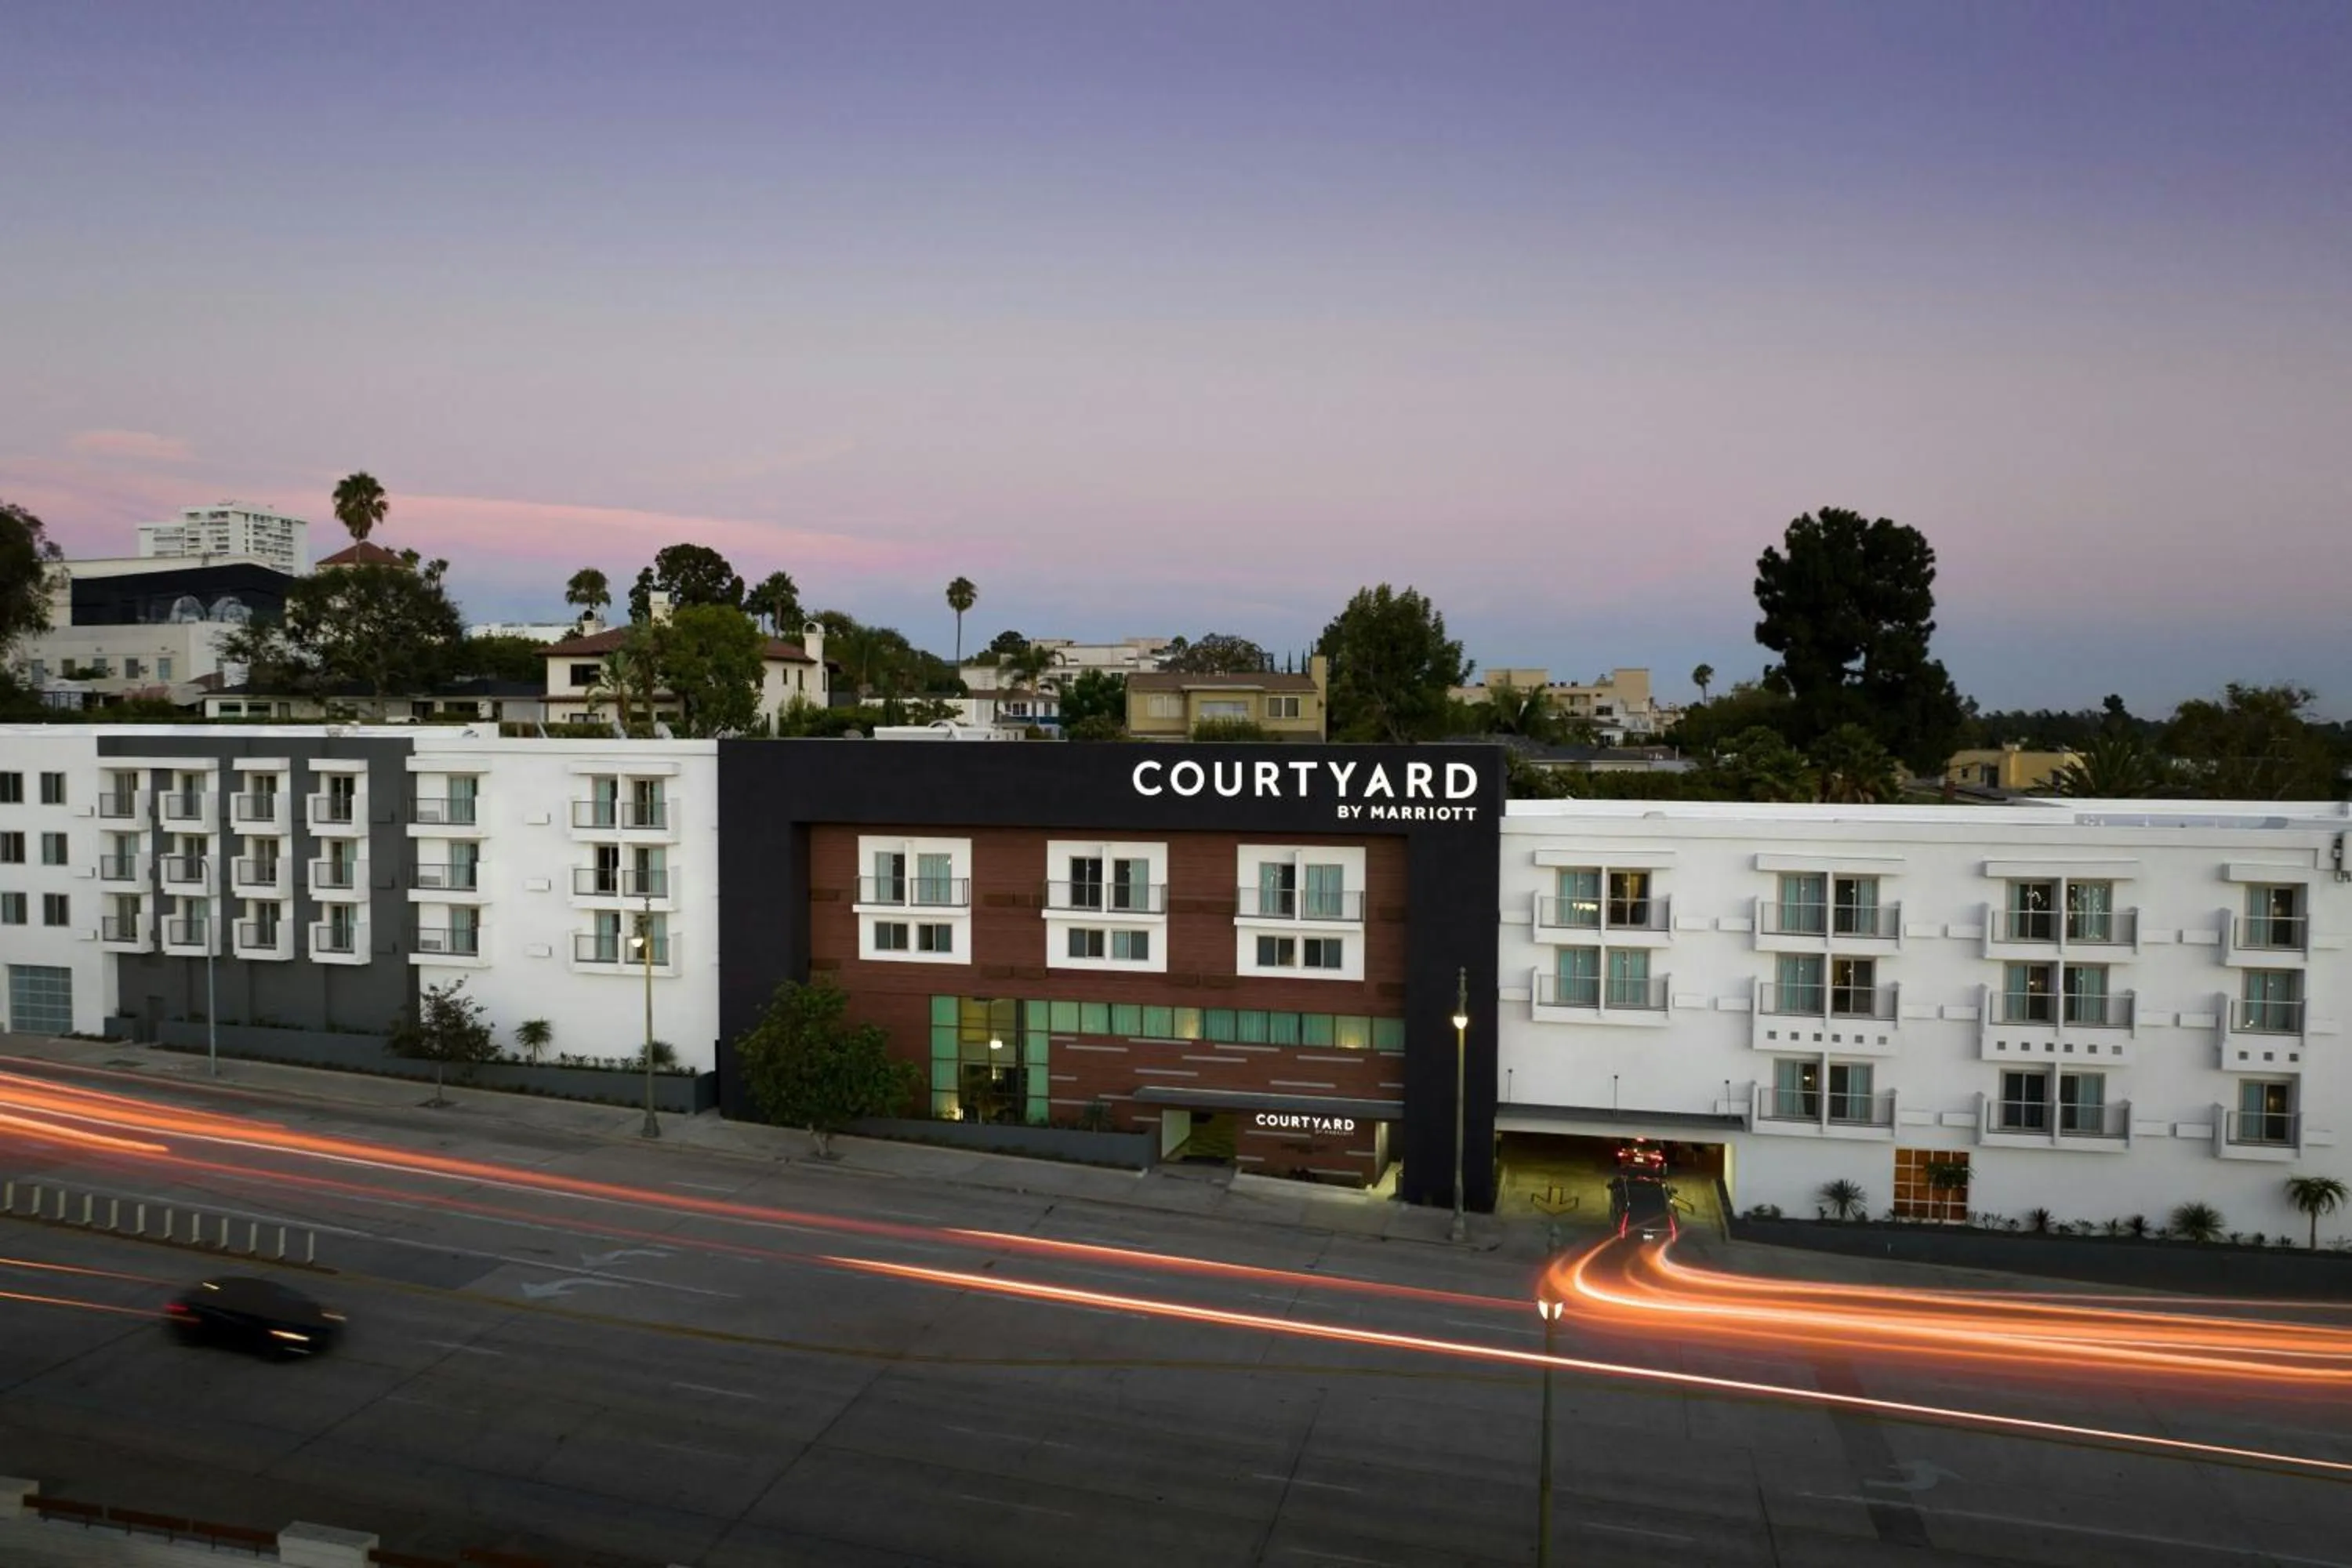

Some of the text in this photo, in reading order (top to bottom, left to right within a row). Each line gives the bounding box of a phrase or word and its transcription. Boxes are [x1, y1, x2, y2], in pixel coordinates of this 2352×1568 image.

[1132, 760, 1478, 799] COURTYARD
[1337, 804, 1477, 821] BY MARRIOTT
[1255, 1113, 1355, 1131] COURTYARD
